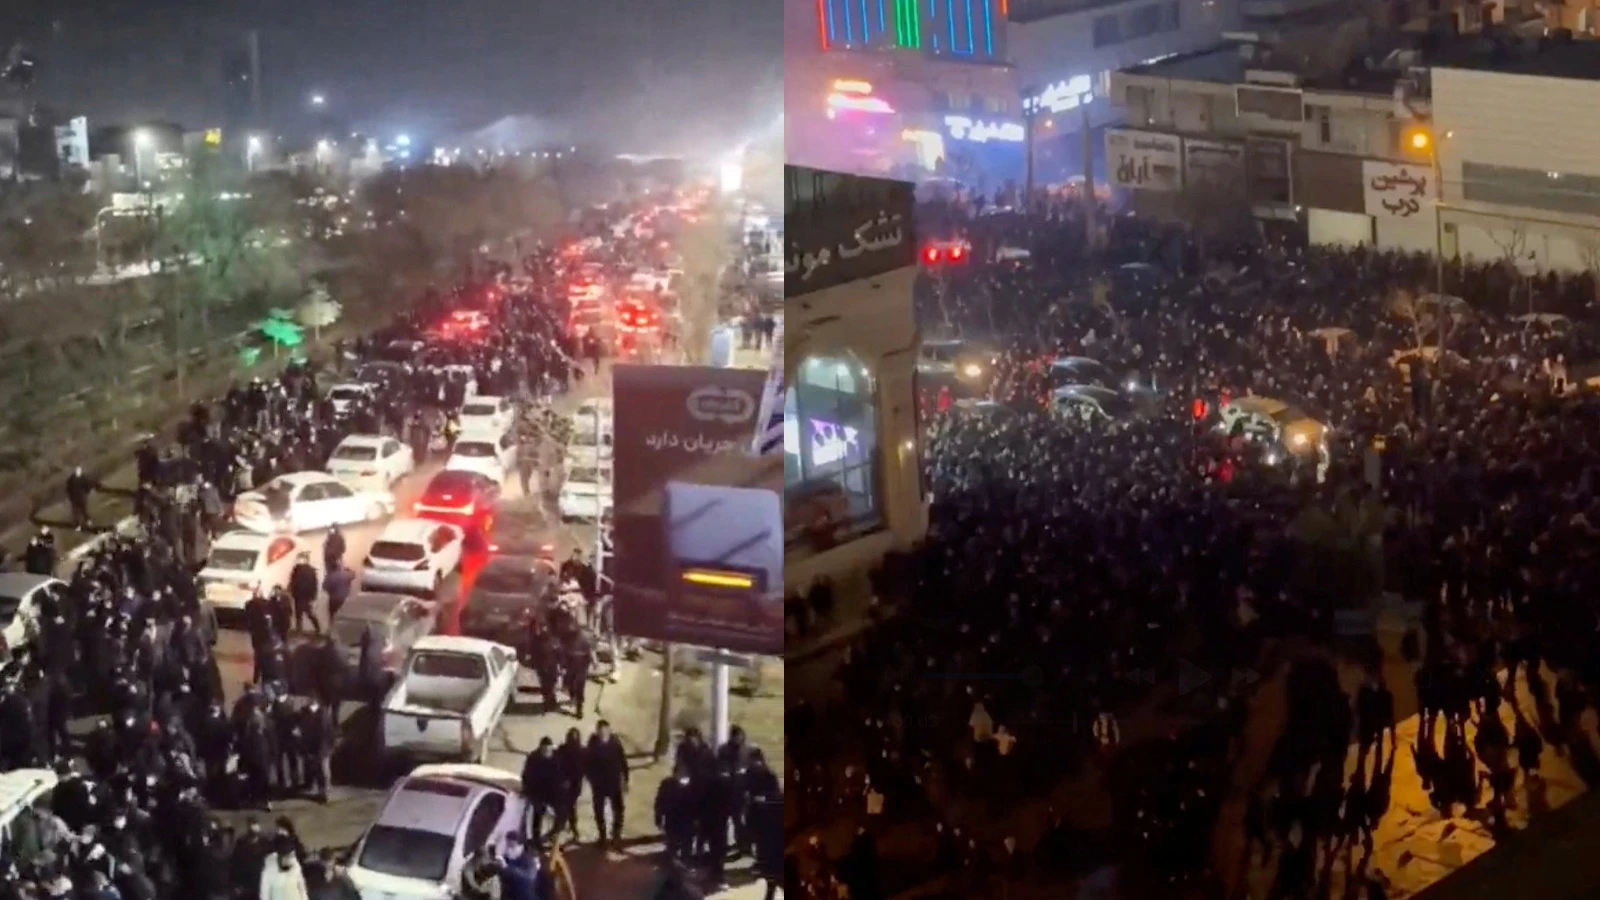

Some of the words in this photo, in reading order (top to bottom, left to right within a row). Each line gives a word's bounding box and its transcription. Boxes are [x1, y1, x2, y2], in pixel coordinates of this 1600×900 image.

[1371, 168, 1426, 197] پرشین
[1382, 198, 1419, 217] درب
[838, 210, 903, 259] تشک
[646, 431, 679, 451] دارد
[683, 432, 736, 455] جریان
